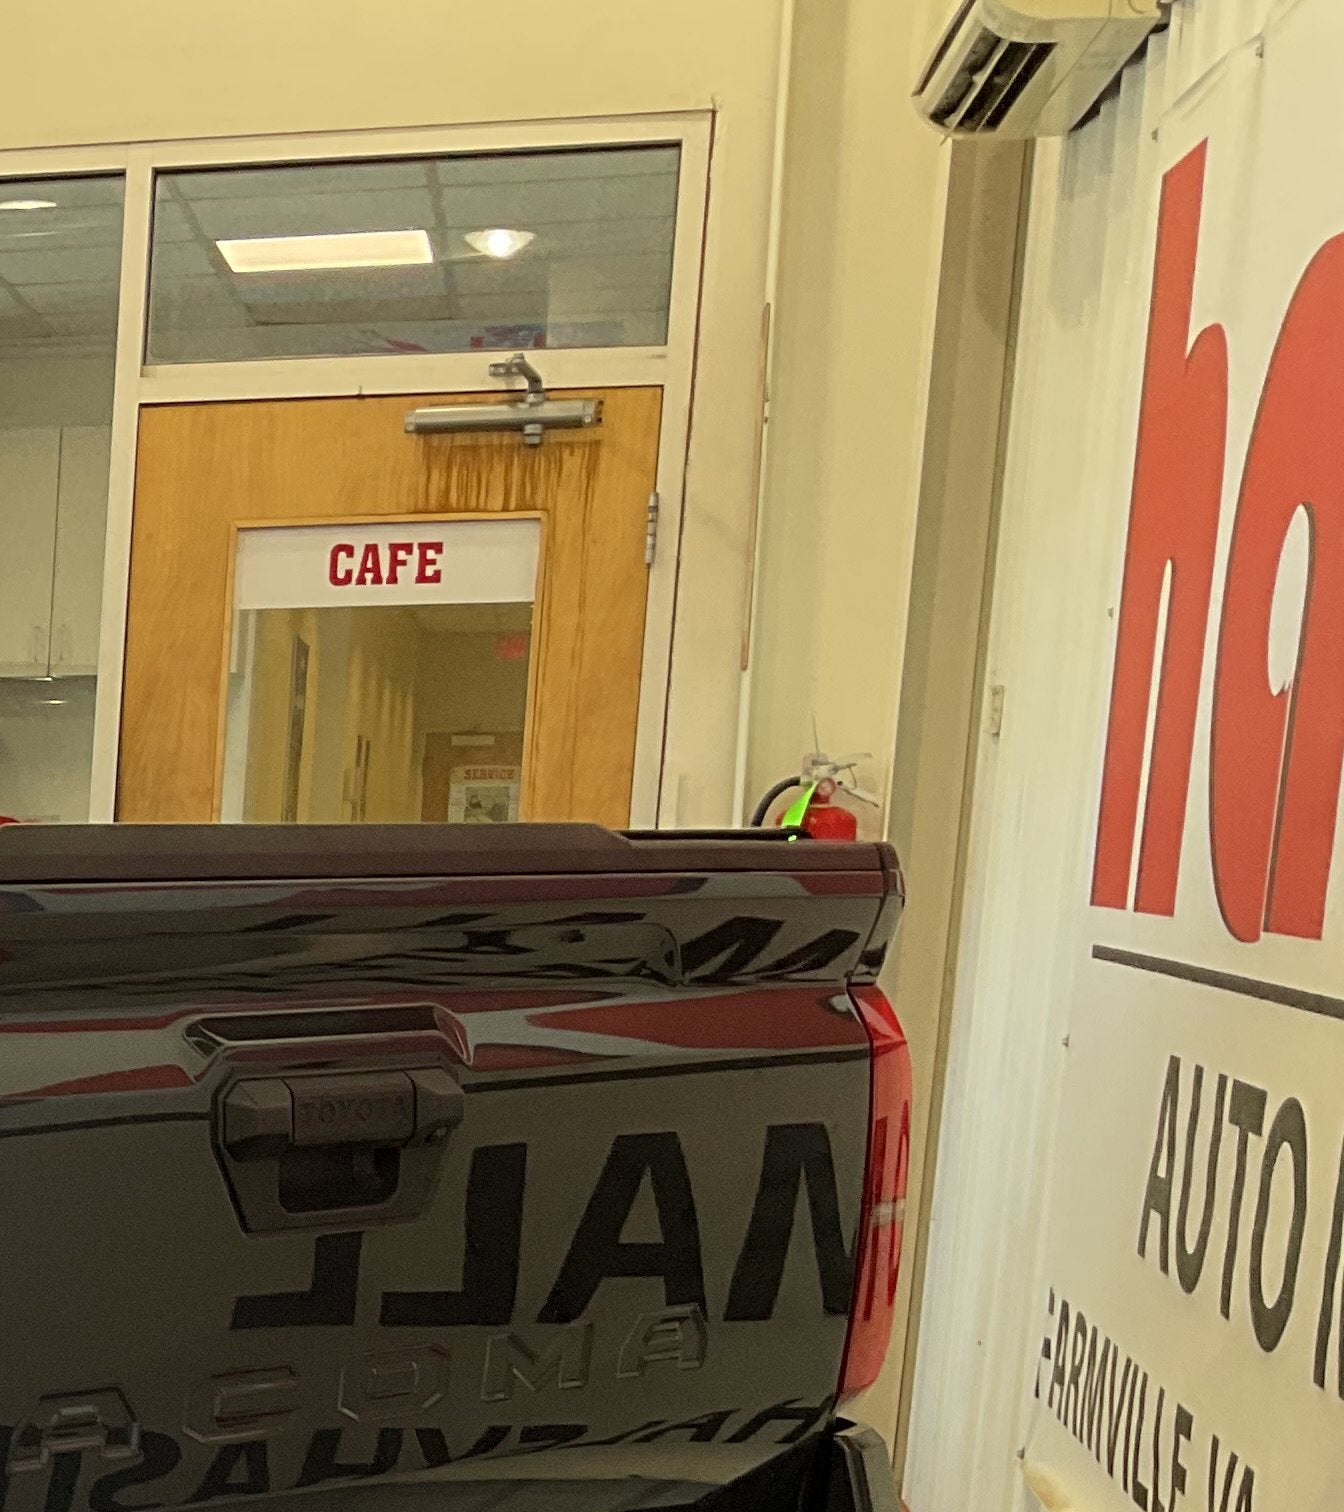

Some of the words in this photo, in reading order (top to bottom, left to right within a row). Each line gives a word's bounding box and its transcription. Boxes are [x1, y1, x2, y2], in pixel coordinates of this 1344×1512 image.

[328, 541, 444, 587] CAFE
[463, 768, 516, 781] SERVICE
[296, 1091, 407, 1127] TOYOTA
[1137, 1054, 1308, 1353] AUTO
